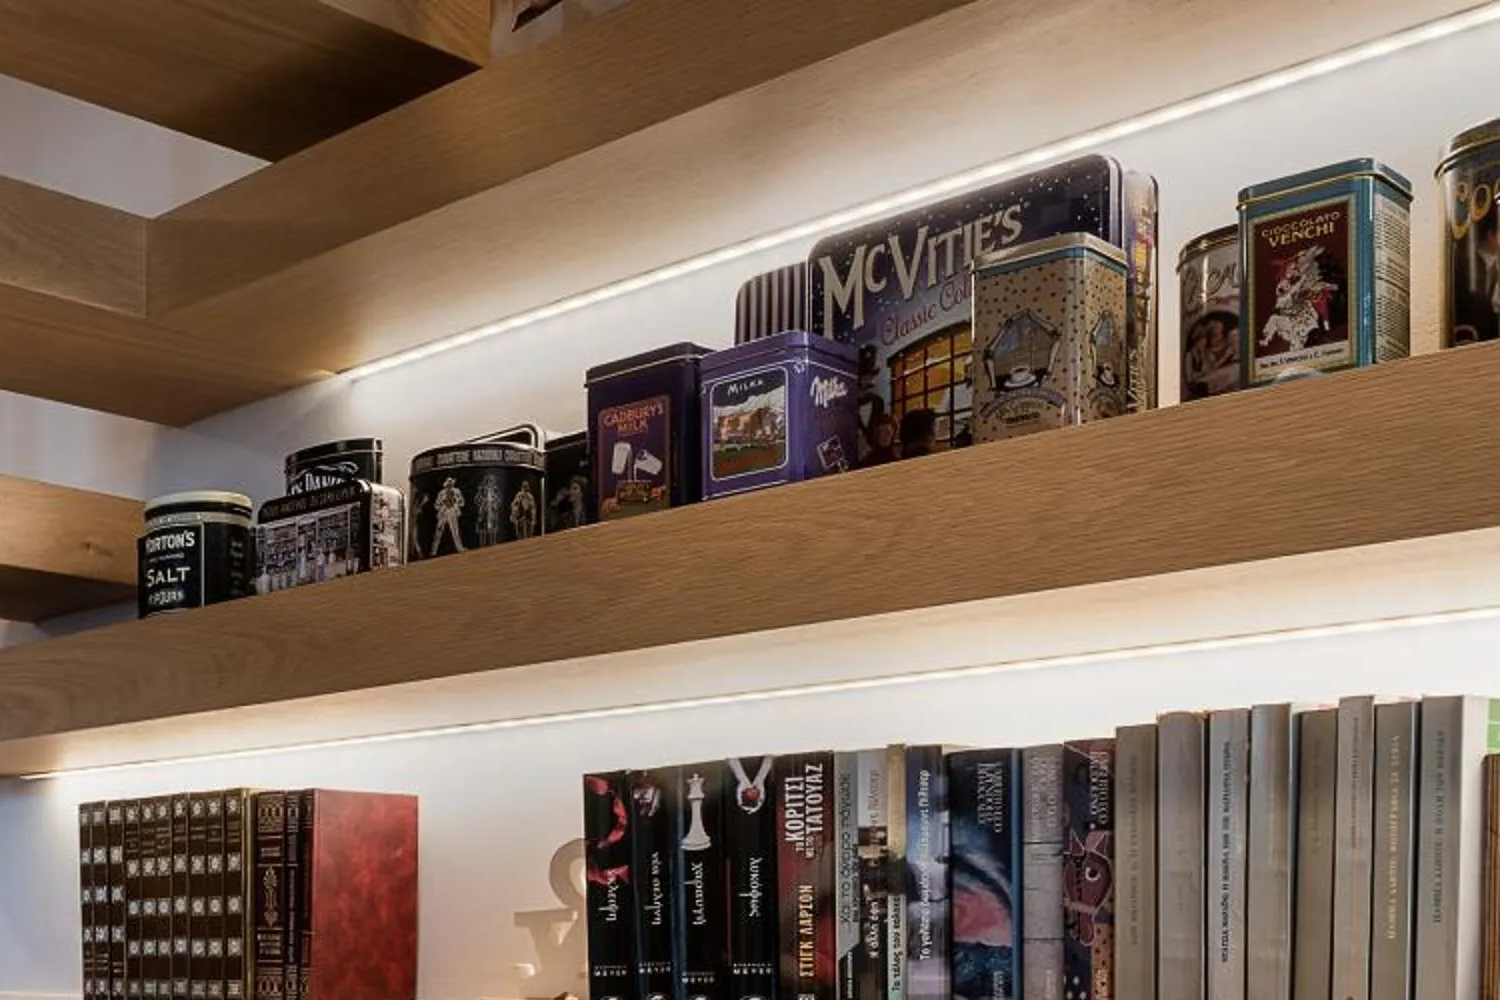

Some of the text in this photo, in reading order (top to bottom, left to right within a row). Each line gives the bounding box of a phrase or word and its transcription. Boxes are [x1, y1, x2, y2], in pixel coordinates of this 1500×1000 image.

[1268, 222, 1335, 248] VENCHI
[147, 566, 191, 588] SALT
[784, 776, 805, 842] ΚΟΡΙΤΣΙ
[805, 763, 823, 834] ΤΑΤΟΥΑΖ
[738, 857, 764, 917] λυκόφως
[799, 884, 814, 977] ΣΤΙΓΚ ΛΑΡΣΟΝ
